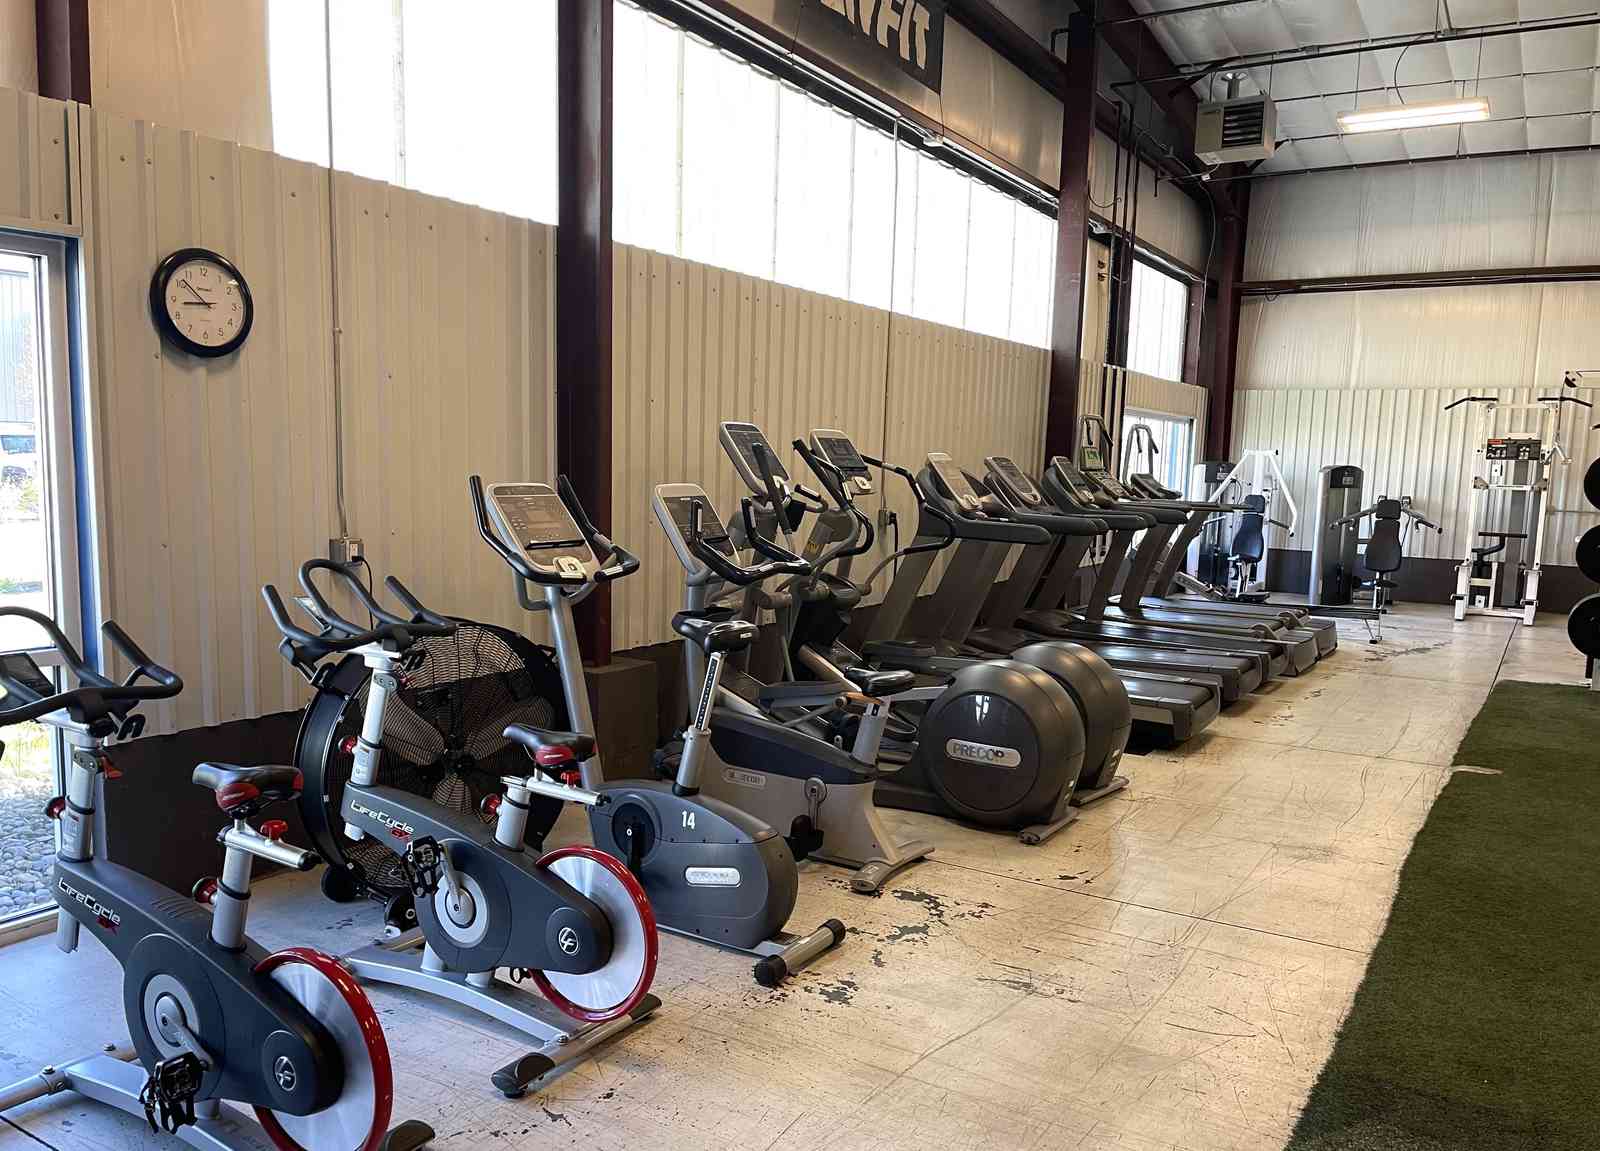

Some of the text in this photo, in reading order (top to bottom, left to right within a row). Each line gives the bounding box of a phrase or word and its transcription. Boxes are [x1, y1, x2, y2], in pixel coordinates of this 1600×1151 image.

[820, 0, 930, 70] FIT
[185, 270, 193, 280] 11
[199, 267, 208, 277] 12
[176, 279, 187, 289] 10
[226, 287, 233, 296] 2
[170, 295, 177, 303] 9
[231, 303, 237, 312] 3
[175, 311, 181, 320] 8
[227, 318, 233, 327] 4
[187, 324, 193, 333] 7
[217, 327, 224, 336] 5
[202, 331, 209, 340] 6
[681, 810, 696, 830] 14
